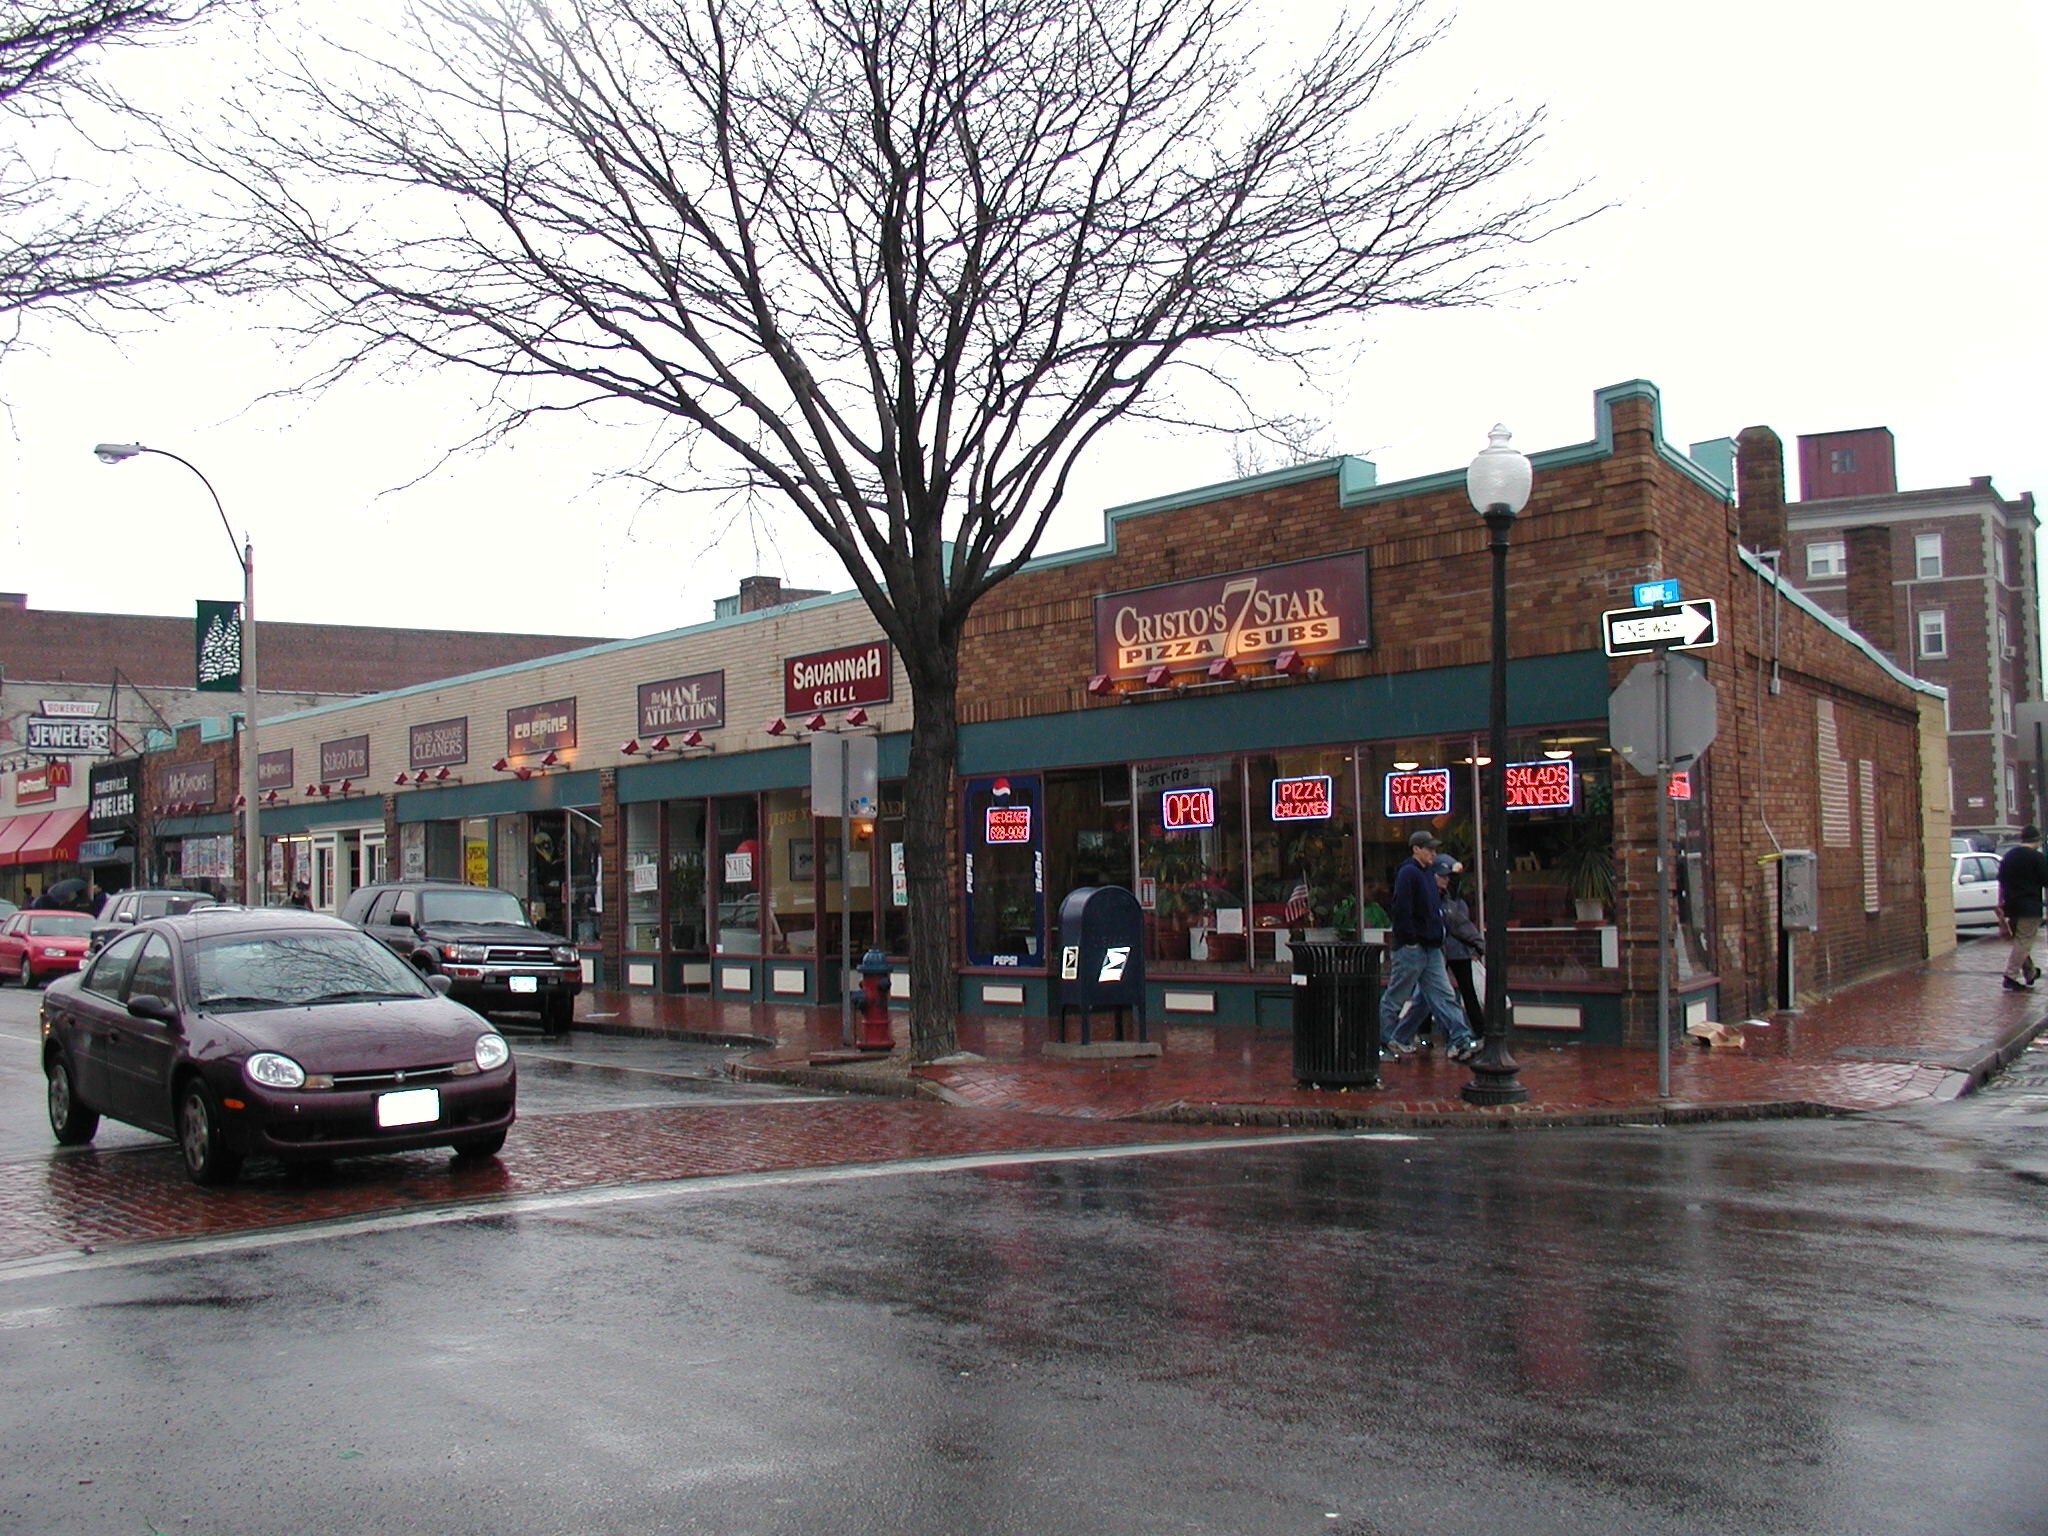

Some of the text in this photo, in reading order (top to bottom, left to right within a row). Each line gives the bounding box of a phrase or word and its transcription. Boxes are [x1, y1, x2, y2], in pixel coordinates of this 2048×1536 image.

[1115, 577, 1328, 658] CRISTO'S 7 STAR
[1244, 622, 1329, 648] SUBS
[1126, 638, 1214, 664] PIZZA
[793, 648, 881, 690] SAVANNAH
[661, 683, 700, 707] MANE
[813, 685, 856, 706] GRILL
[47, 703, 95, 714] SOMERVILLE
[644, 701, 717, 727] ATTRACTION
[30, 724, 108, 748] JEWELERS
[413, 726, 462, 745] DAVIS SQUARE
[349, 748, 365, 768] PUB
[413, 739, 463, 760] CLEANERS
[95, 776, 128, 795] SOMERVILLE
[1392, 775, 1446, 795] STEAKS
[1506, 765, 1568, 787] SALADS
[1282, 782, 1325, 801] PIZZA
[1506, 785, 1569, 806] DINNERS
[90, 793, 134, 819] JEWELERS
[1166, 793, 1212, 825] OPEN
[1275, 801, 1329, 817] CALZONES
[1394, 793, 1444, 812] WINGS
[725, 857, 751, 876] NAILS
[965, 853, 974, 893] PEPSI
[1034, 851, 1043, 893] PEPSI
[993, 954, 1018, 966] PEPSI
